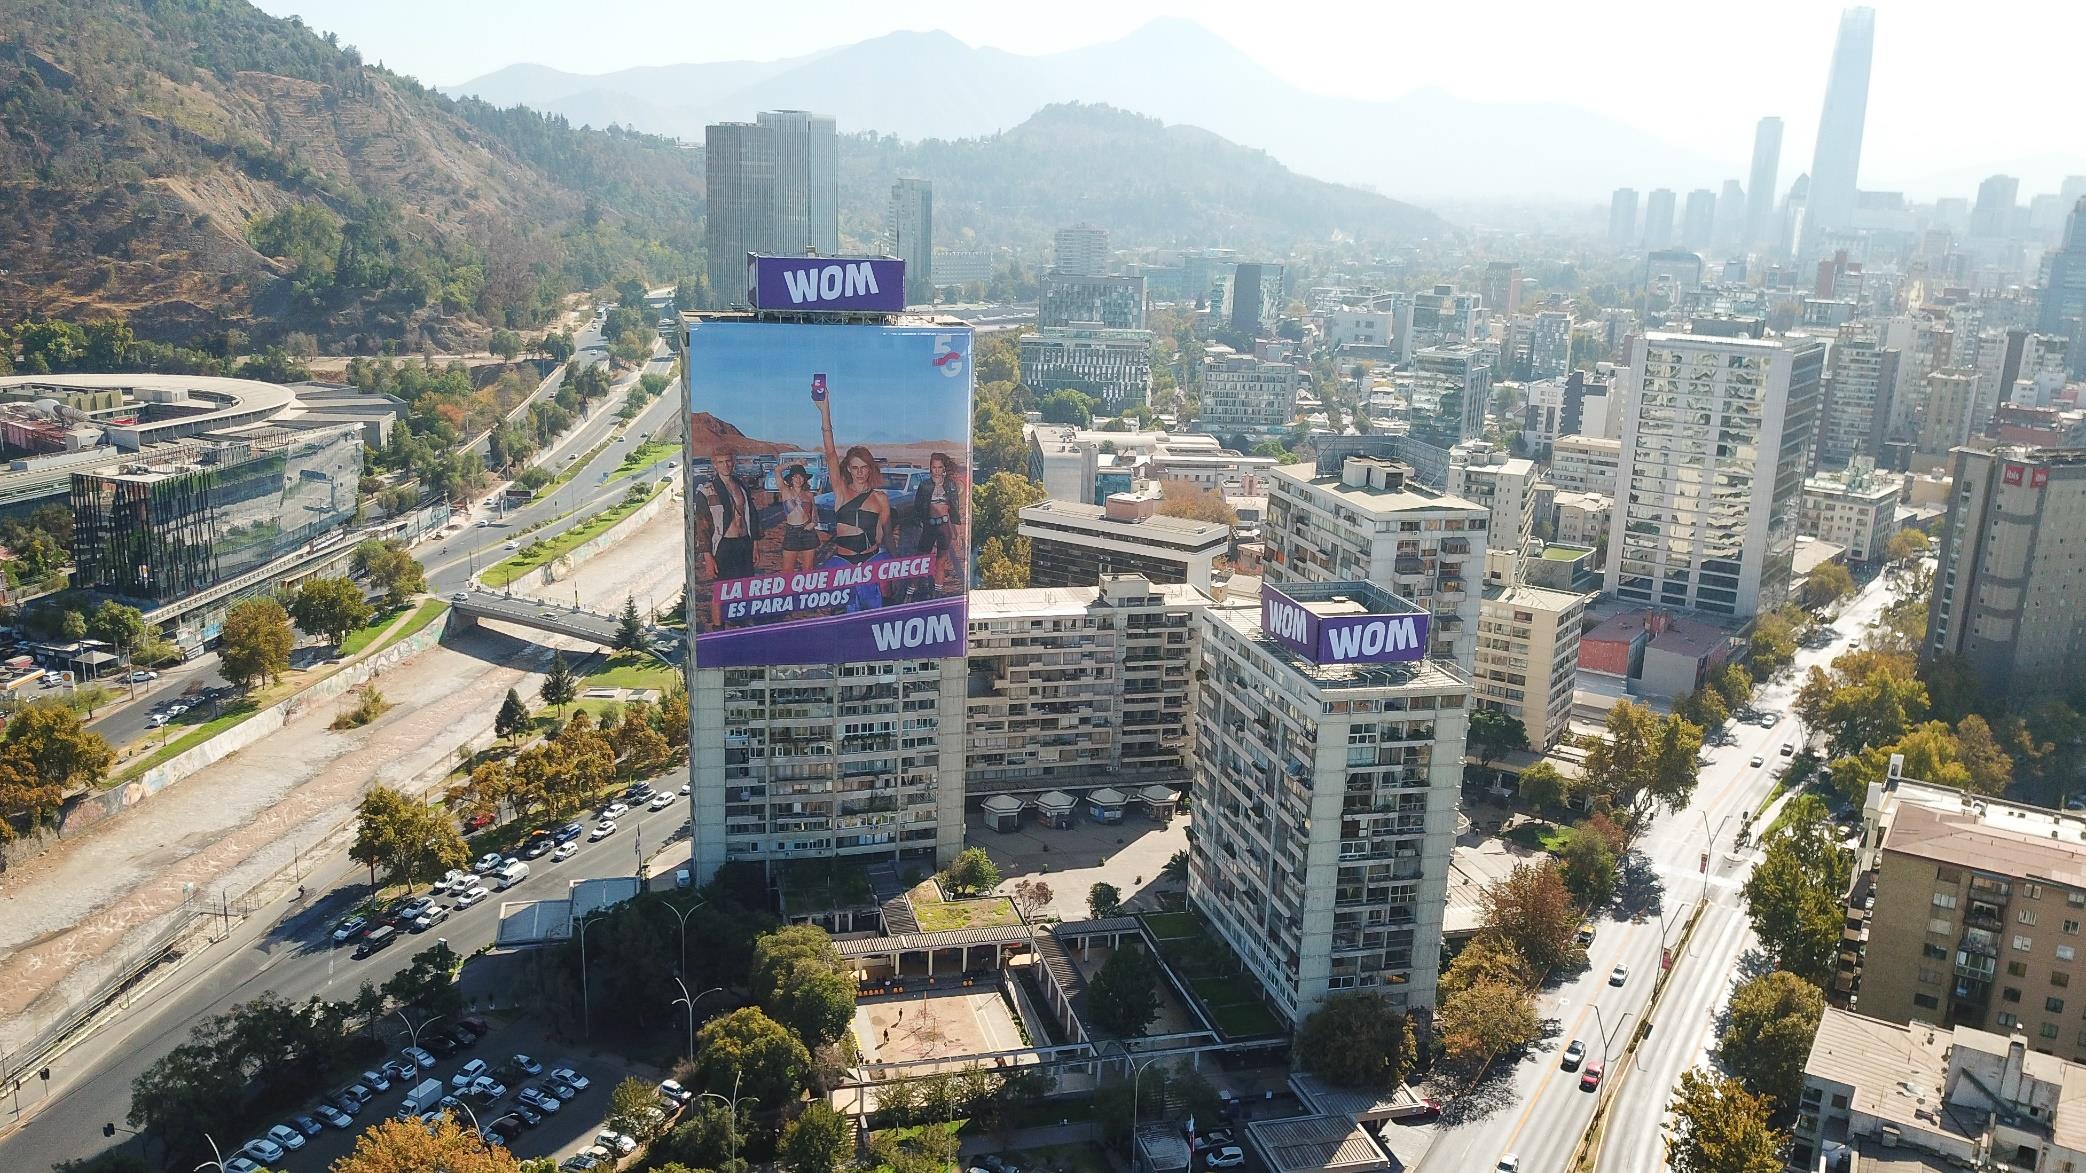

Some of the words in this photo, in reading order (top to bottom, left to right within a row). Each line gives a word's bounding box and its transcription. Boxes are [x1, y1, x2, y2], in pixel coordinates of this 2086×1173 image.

[784, 262, 879, 304] WOM
[720, 582, 742, 600] LA
[748, 578, 785, 596] RED
[791, 572, 827, 592] QUE
[833, 563, 873, 585] MÁS
[878, 558, 930, 580] CRECE
[728, 602, 746, 618] ES
[750, 598, 793, 615] PARA
[799, 589, 849, 609] TODOS
[1269, 600, 1307, 644] WOM
[872, 614, 956, 652] WOM
[1328, 617, 1418, 660] WOM
